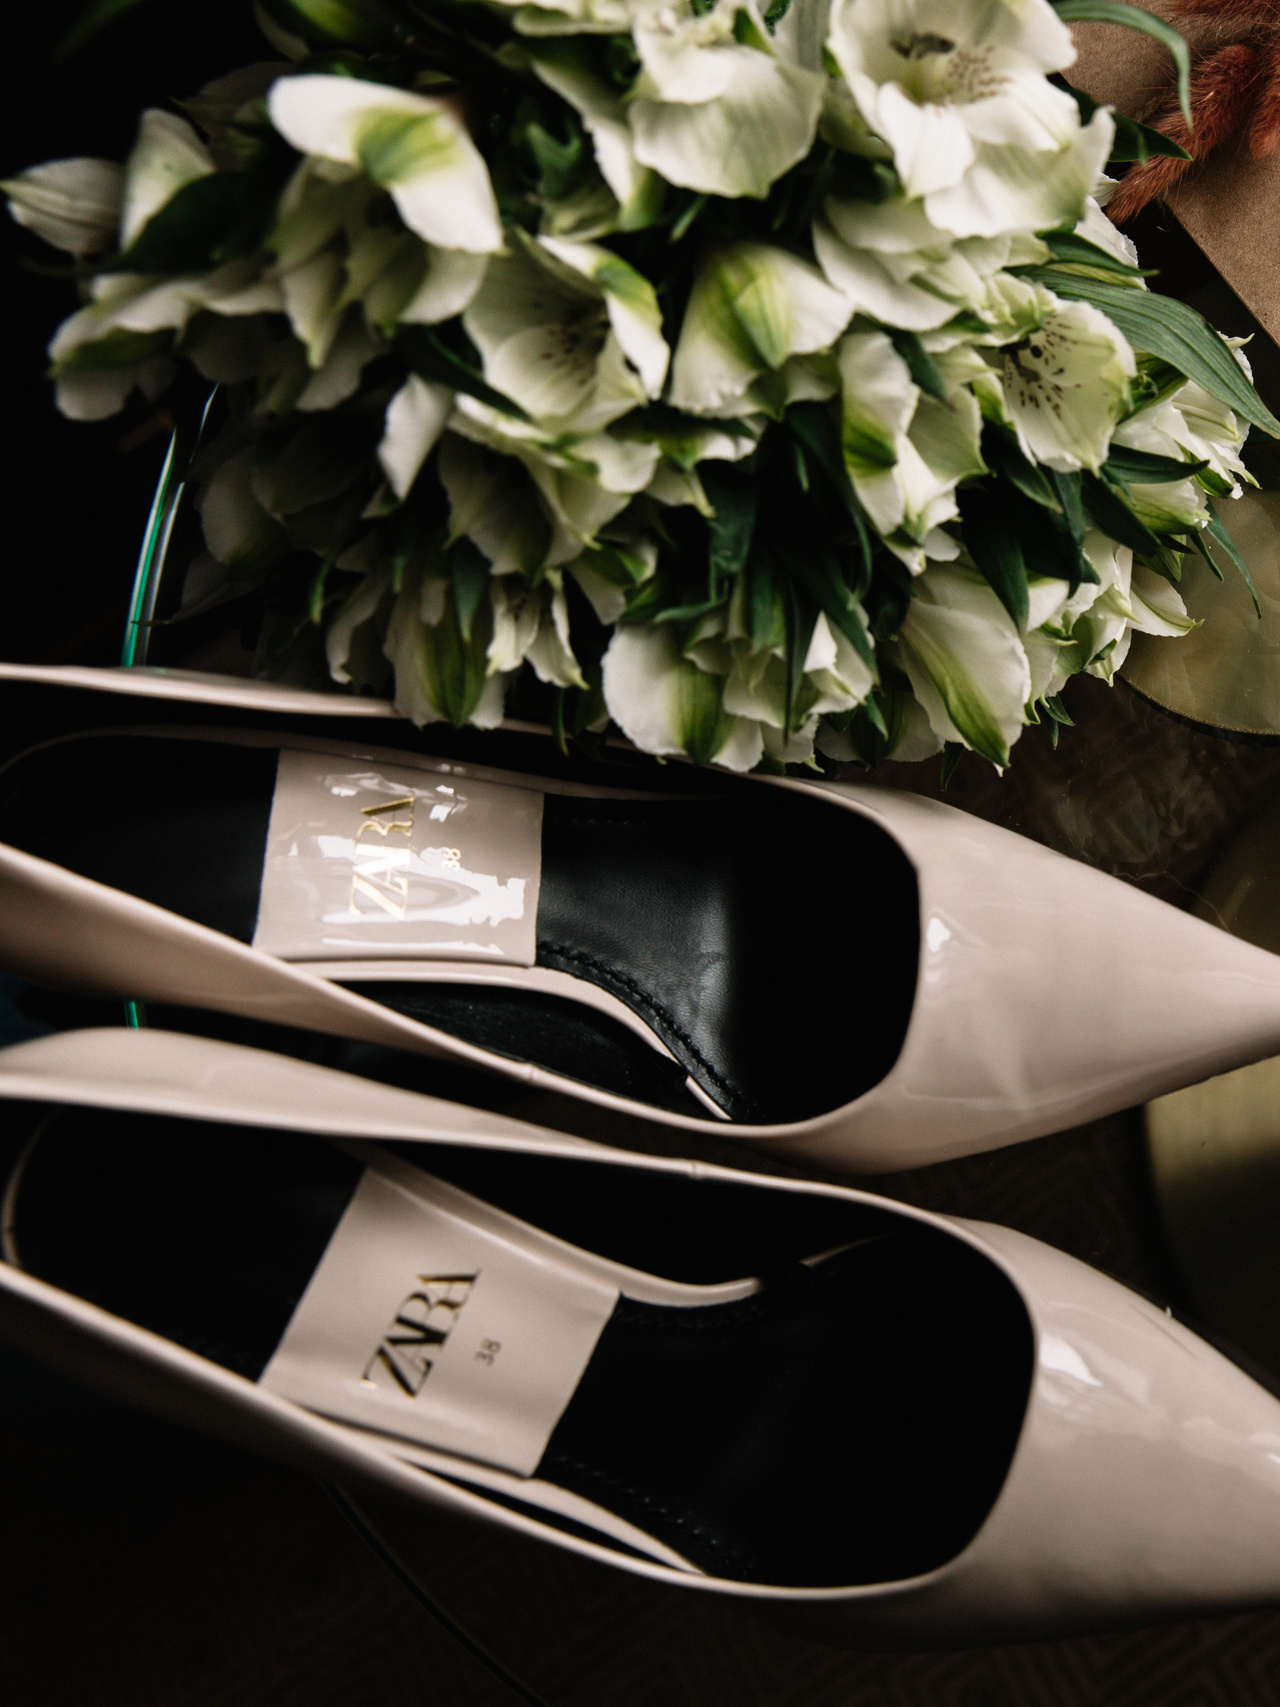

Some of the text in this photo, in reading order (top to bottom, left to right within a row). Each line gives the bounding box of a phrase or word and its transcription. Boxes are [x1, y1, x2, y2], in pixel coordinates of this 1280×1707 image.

[349, 792, 415, 921] ZARA
[441, 848, 462, 871] 38
[361, 1268, 482, 1400] ZARA
[474, 1338, 502, 1367] 38
